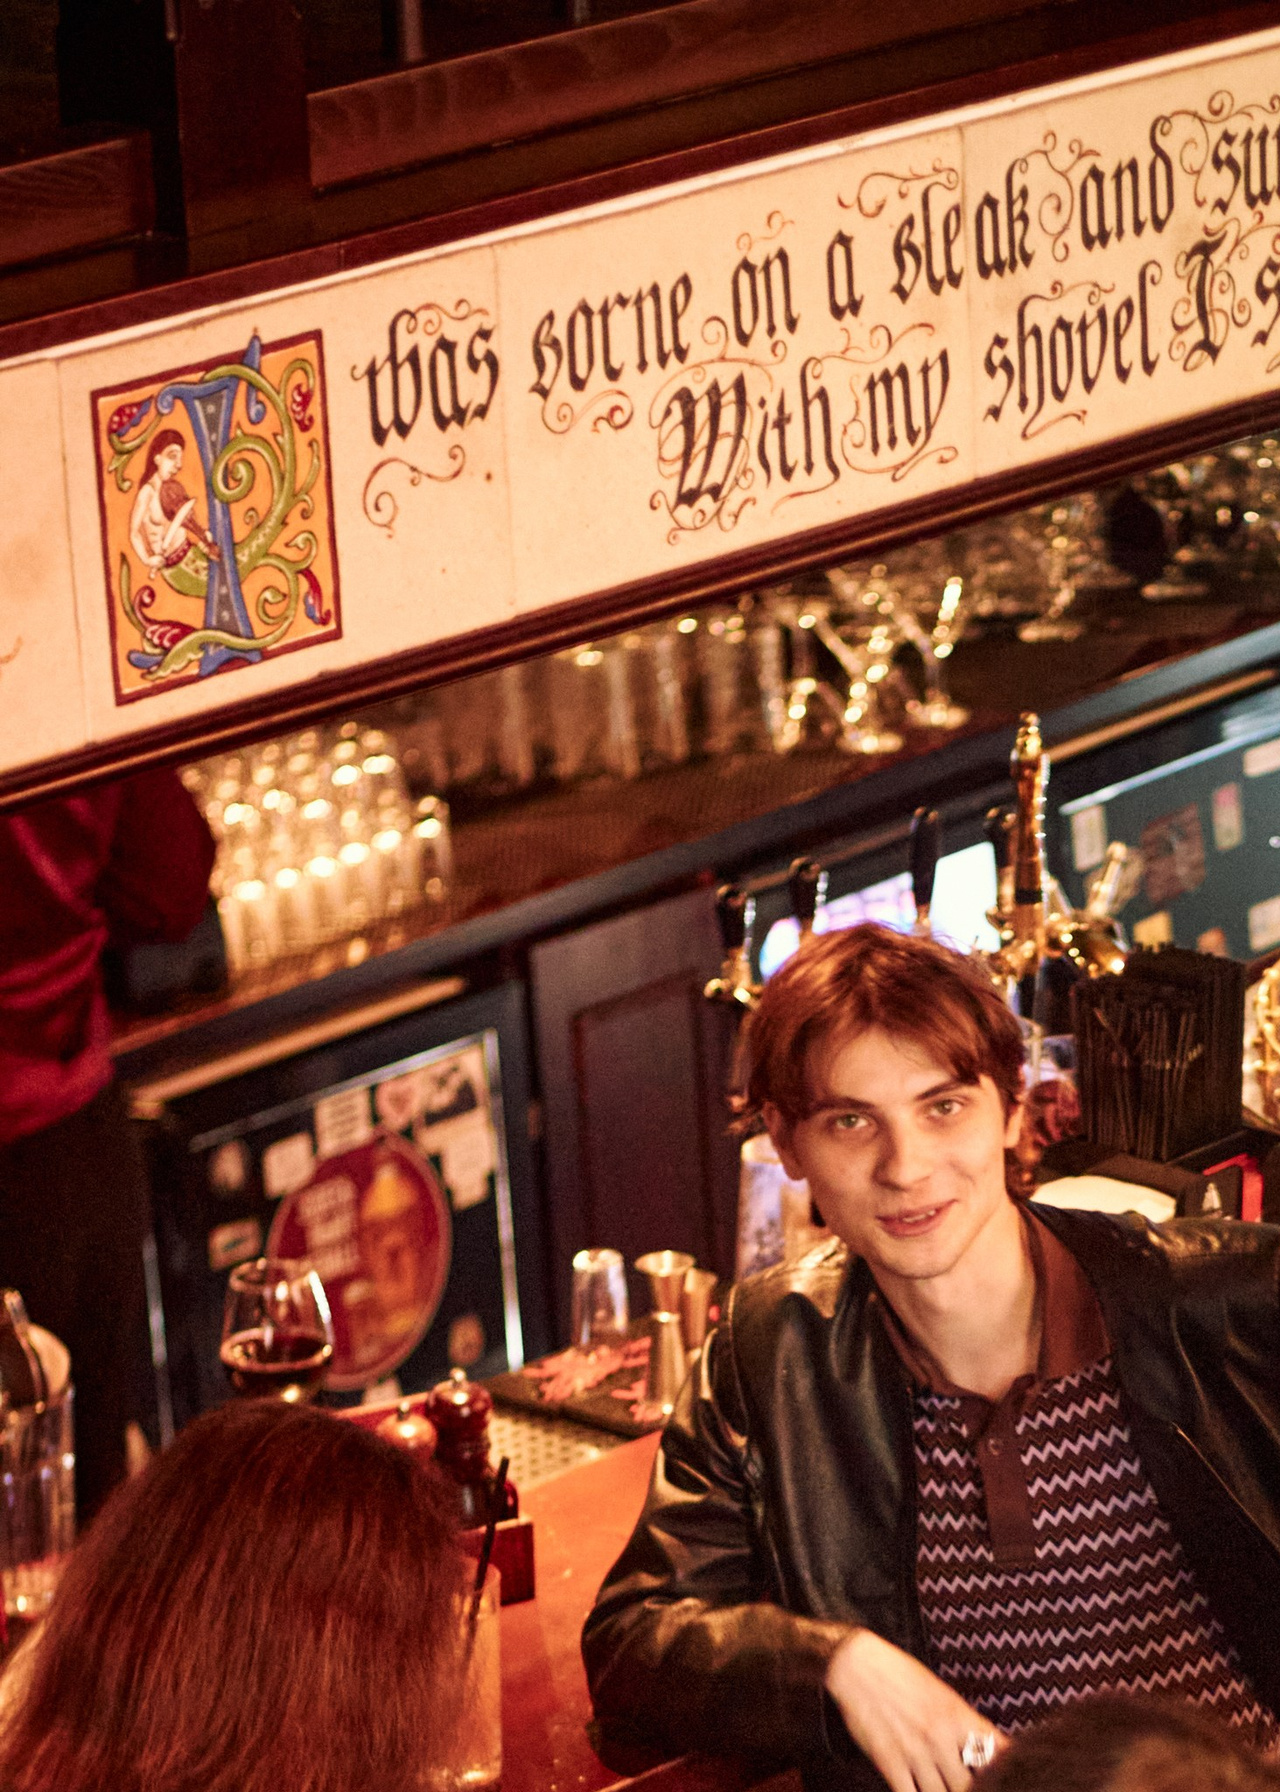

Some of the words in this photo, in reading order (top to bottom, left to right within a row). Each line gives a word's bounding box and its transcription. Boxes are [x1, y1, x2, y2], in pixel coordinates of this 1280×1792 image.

[353, 308, 500, 447] was
[730, 246, 801, 347] on
[826, 230, 864, 322] a
[1079, 116, 1176, 252] and
[656, 357, 842, 512] With
[864, 348, 951, 475] my
[984, 260, 1163, 436] shovel
